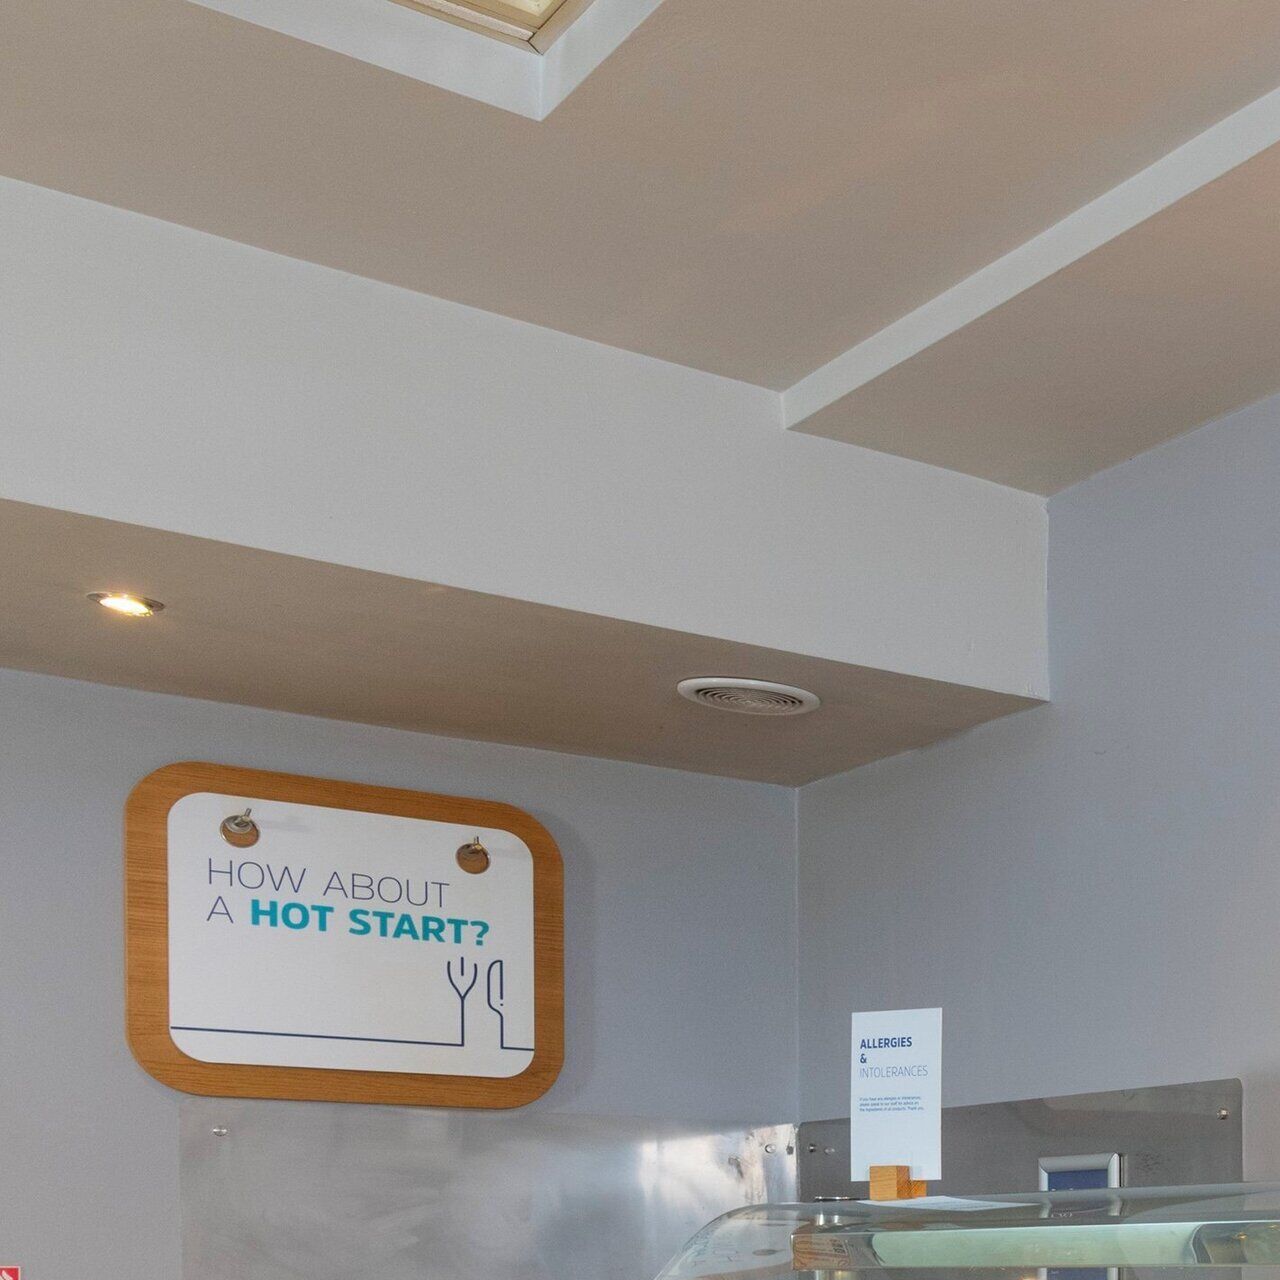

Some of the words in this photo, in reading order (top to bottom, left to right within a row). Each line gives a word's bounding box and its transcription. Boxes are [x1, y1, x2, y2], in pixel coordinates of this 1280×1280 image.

[207, 857, 307, 894] HOW
[323, 871, 450, 909] ABOUT
[206, 895, 234, 924] A
[250, 898, 335, 932] HOT
[349, 908, 490, 946] START?
[860, 1036, 913, 1050] ALLERGIES
[860, 1053, 867, 1064] &
[859, 1065, 929, 1079] INTOLERANCES
